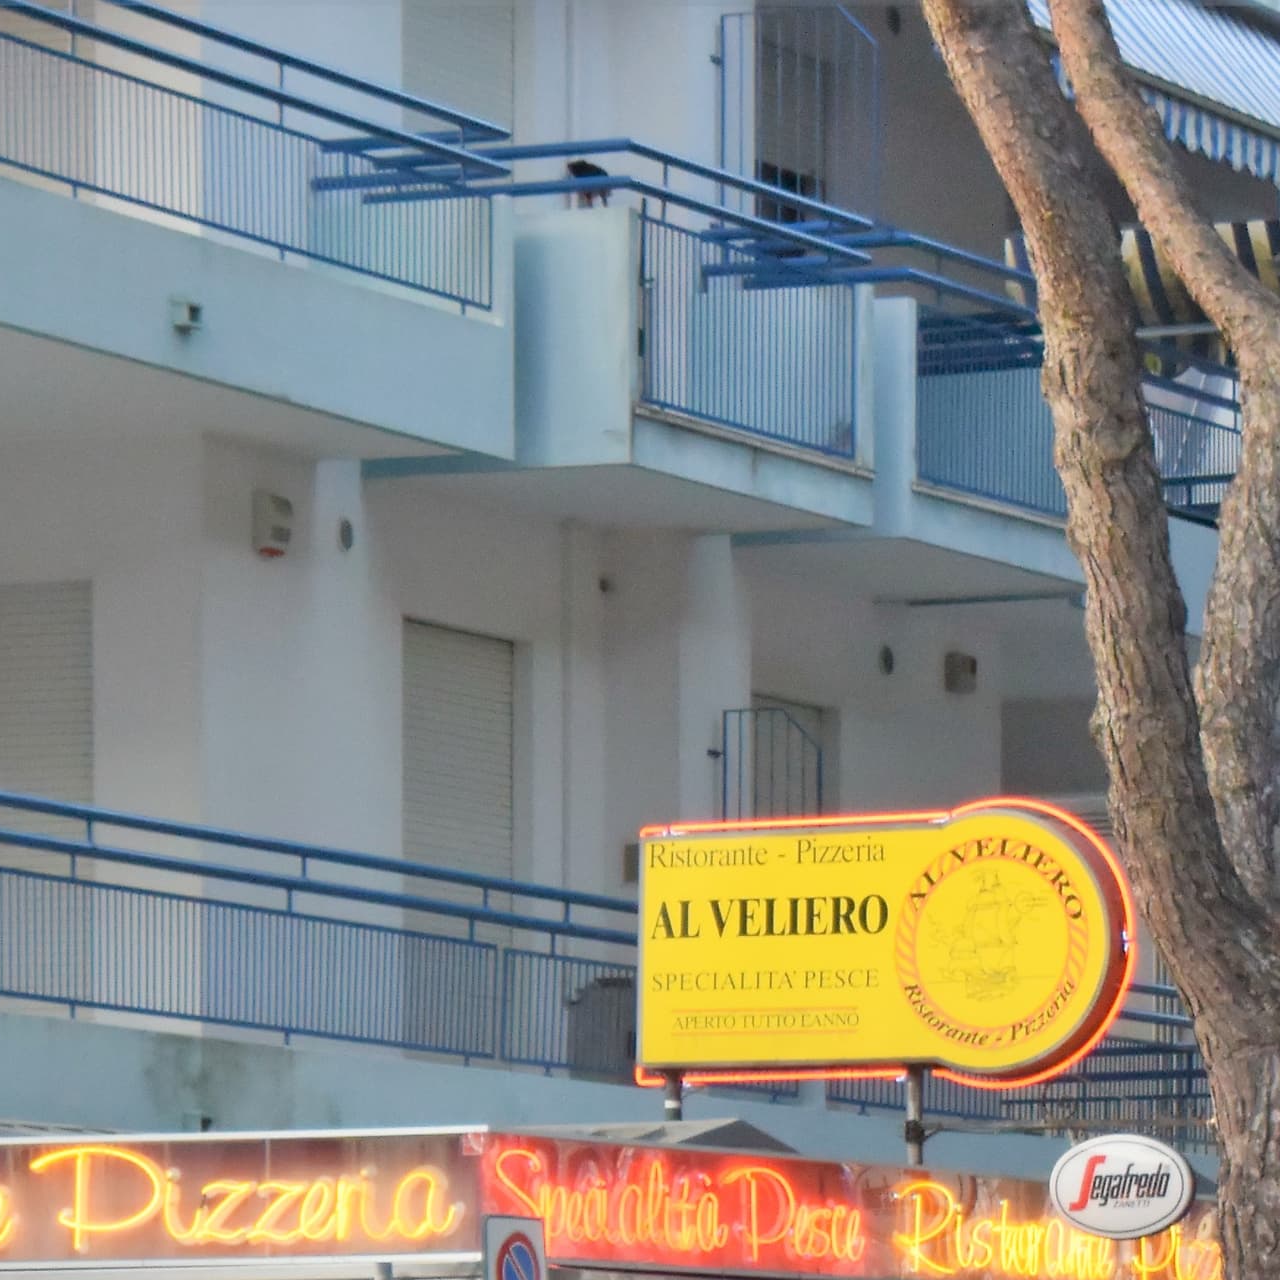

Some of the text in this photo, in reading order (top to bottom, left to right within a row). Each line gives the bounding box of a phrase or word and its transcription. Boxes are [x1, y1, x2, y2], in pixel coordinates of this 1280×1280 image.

[650, 843, 768, 868] Ristorante
[796, 836, 886, 864] Pizzeria
[909, 838, 1082, 920] AL VELIERO
[651, 894, 888, 939] AL VELIERO
[804, 968, 879, 990] PESCE
[672, 1015, 736, 1031] APERTO
[742, 1013, 796, 1029] TUTTO
[904, 984, 989, 1046] Ristorante
[1011, 980, 1075, 1042] Pizzeria
[29, 1145, 458, 1252] Pizzeria
[1068, 1155, 1170, 1211] Segafredo
[723, 1166, 865, 1263] Pesce
